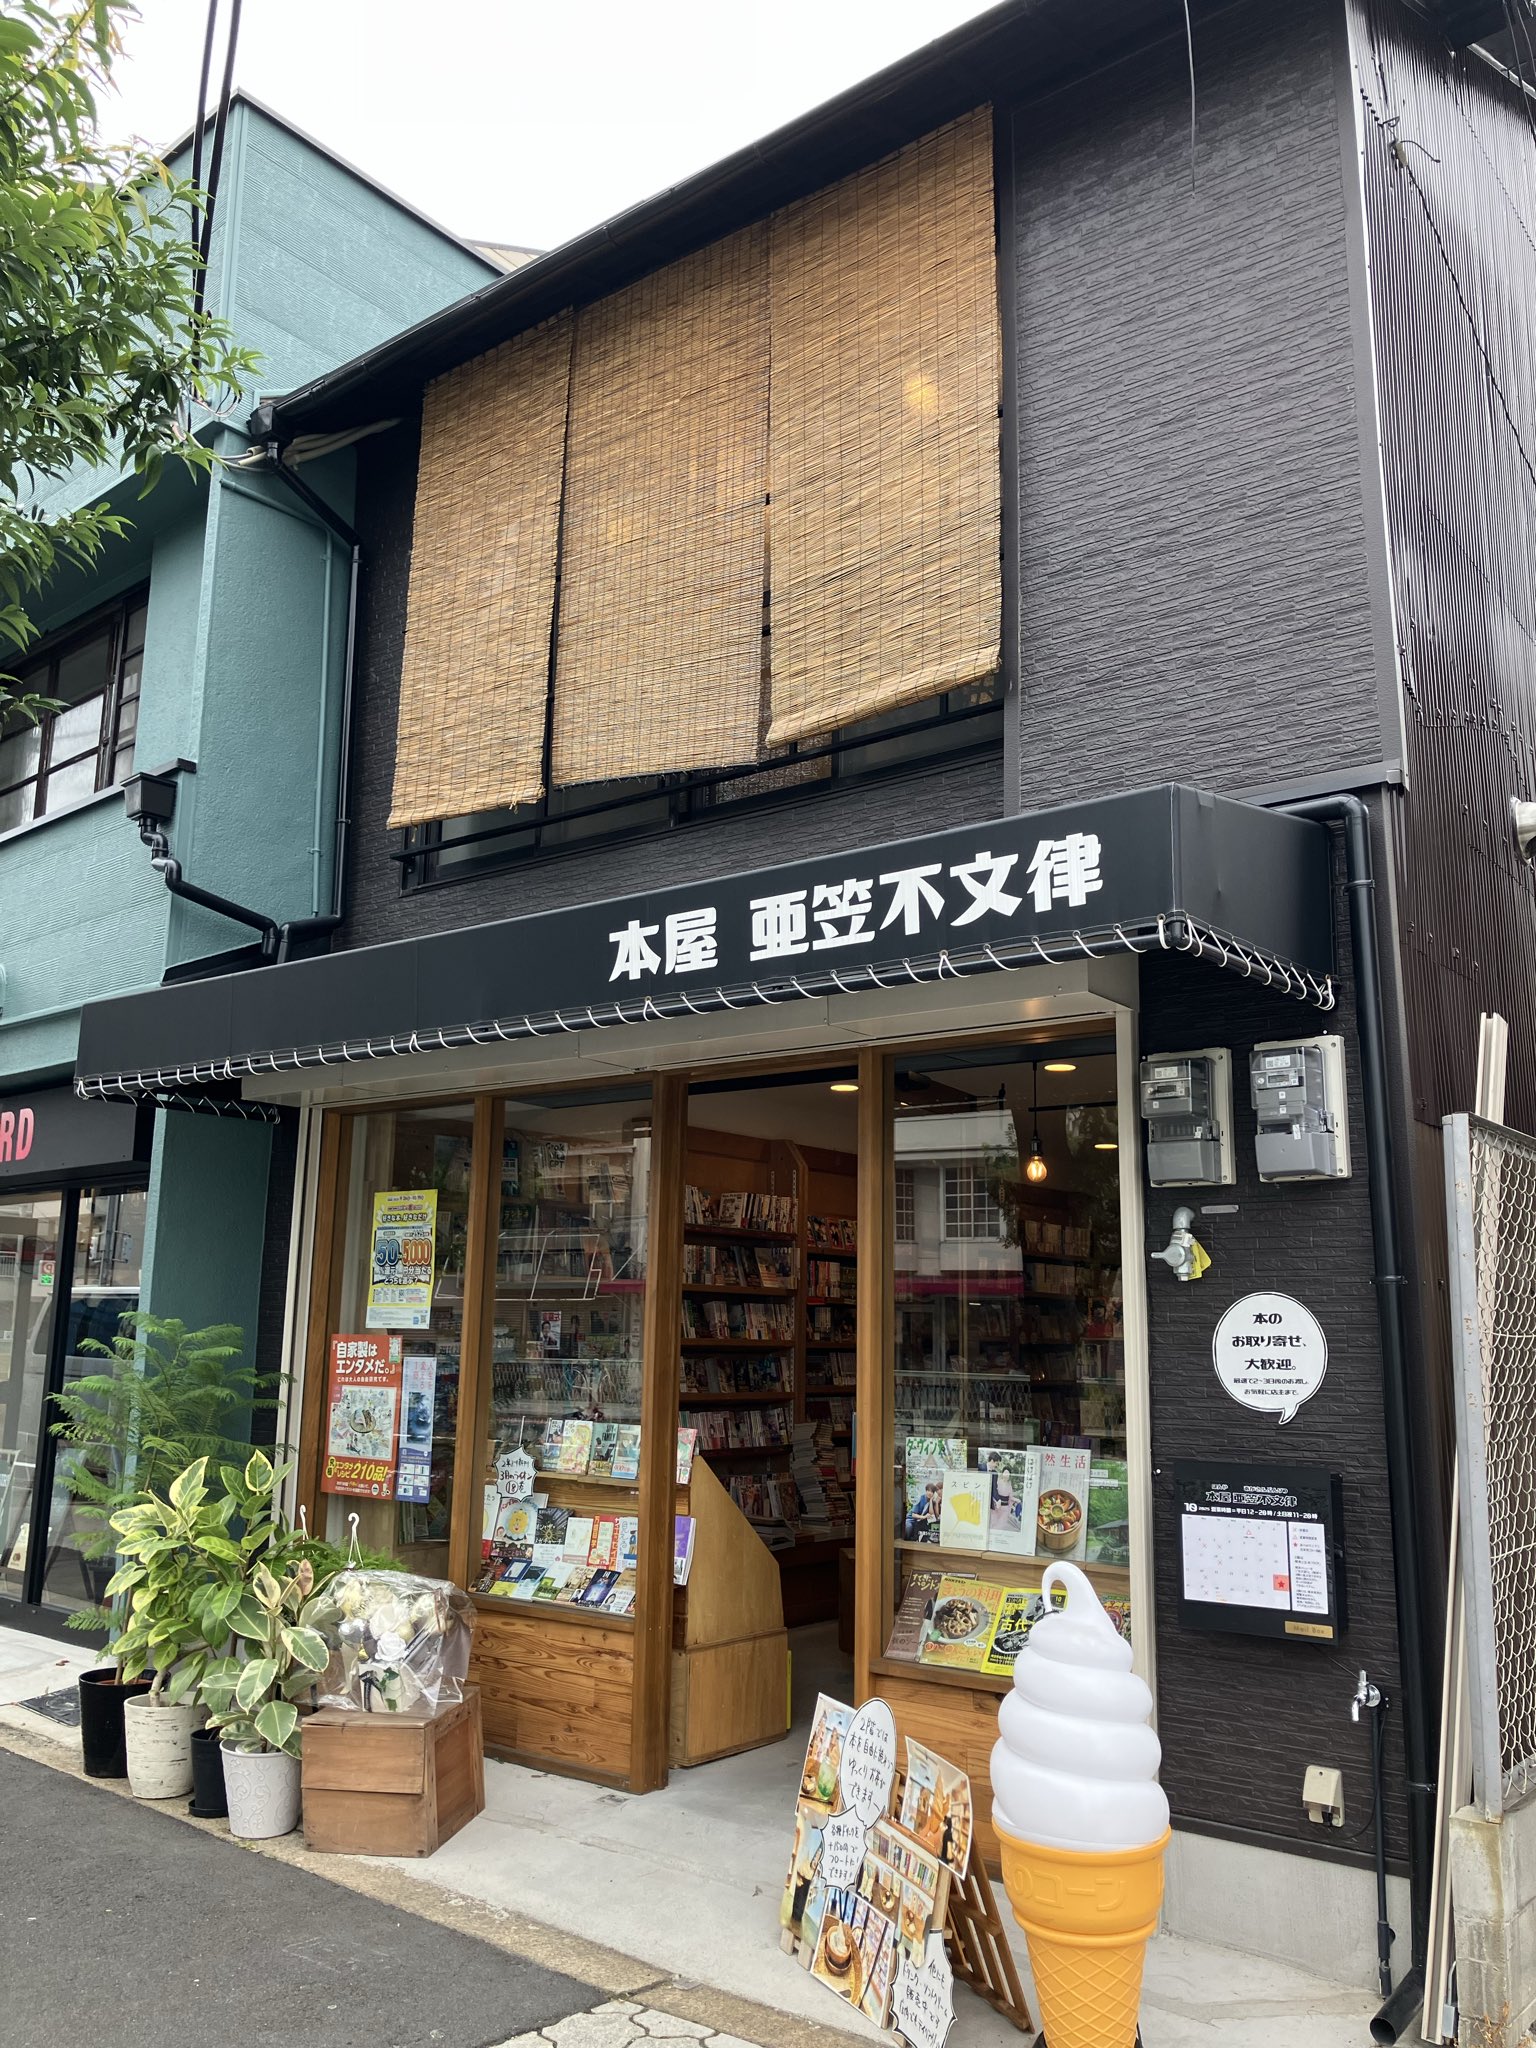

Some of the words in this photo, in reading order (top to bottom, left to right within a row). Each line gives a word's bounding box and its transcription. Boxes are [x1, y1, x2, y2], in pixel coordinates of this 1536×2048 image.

[609, 906, 718, 983] 本屋
[749, 831, 1103, 962] 亜笠不文律
[376, 1239, 400, 1266] 50
[402, 1238, 432, 1266] 5,000
[1253, 1312, 1283, 1325] 本の
[1232, 1335, 1307, 1348] お取り寄せ、
[1244, 1358, 1297, 1371] 大歓迎。
[1045, 1453, 1086, 1469] 然生活
[951, 1481, 981, 1489] スピン
[1206, 1491, 1231, 1503] 本屋
[1232, 1492, 1298, 1507] 亜笠不文律
[1184, 1502, 1198, 1512] 10
[860, 1717, 889, 1743] 2階では
